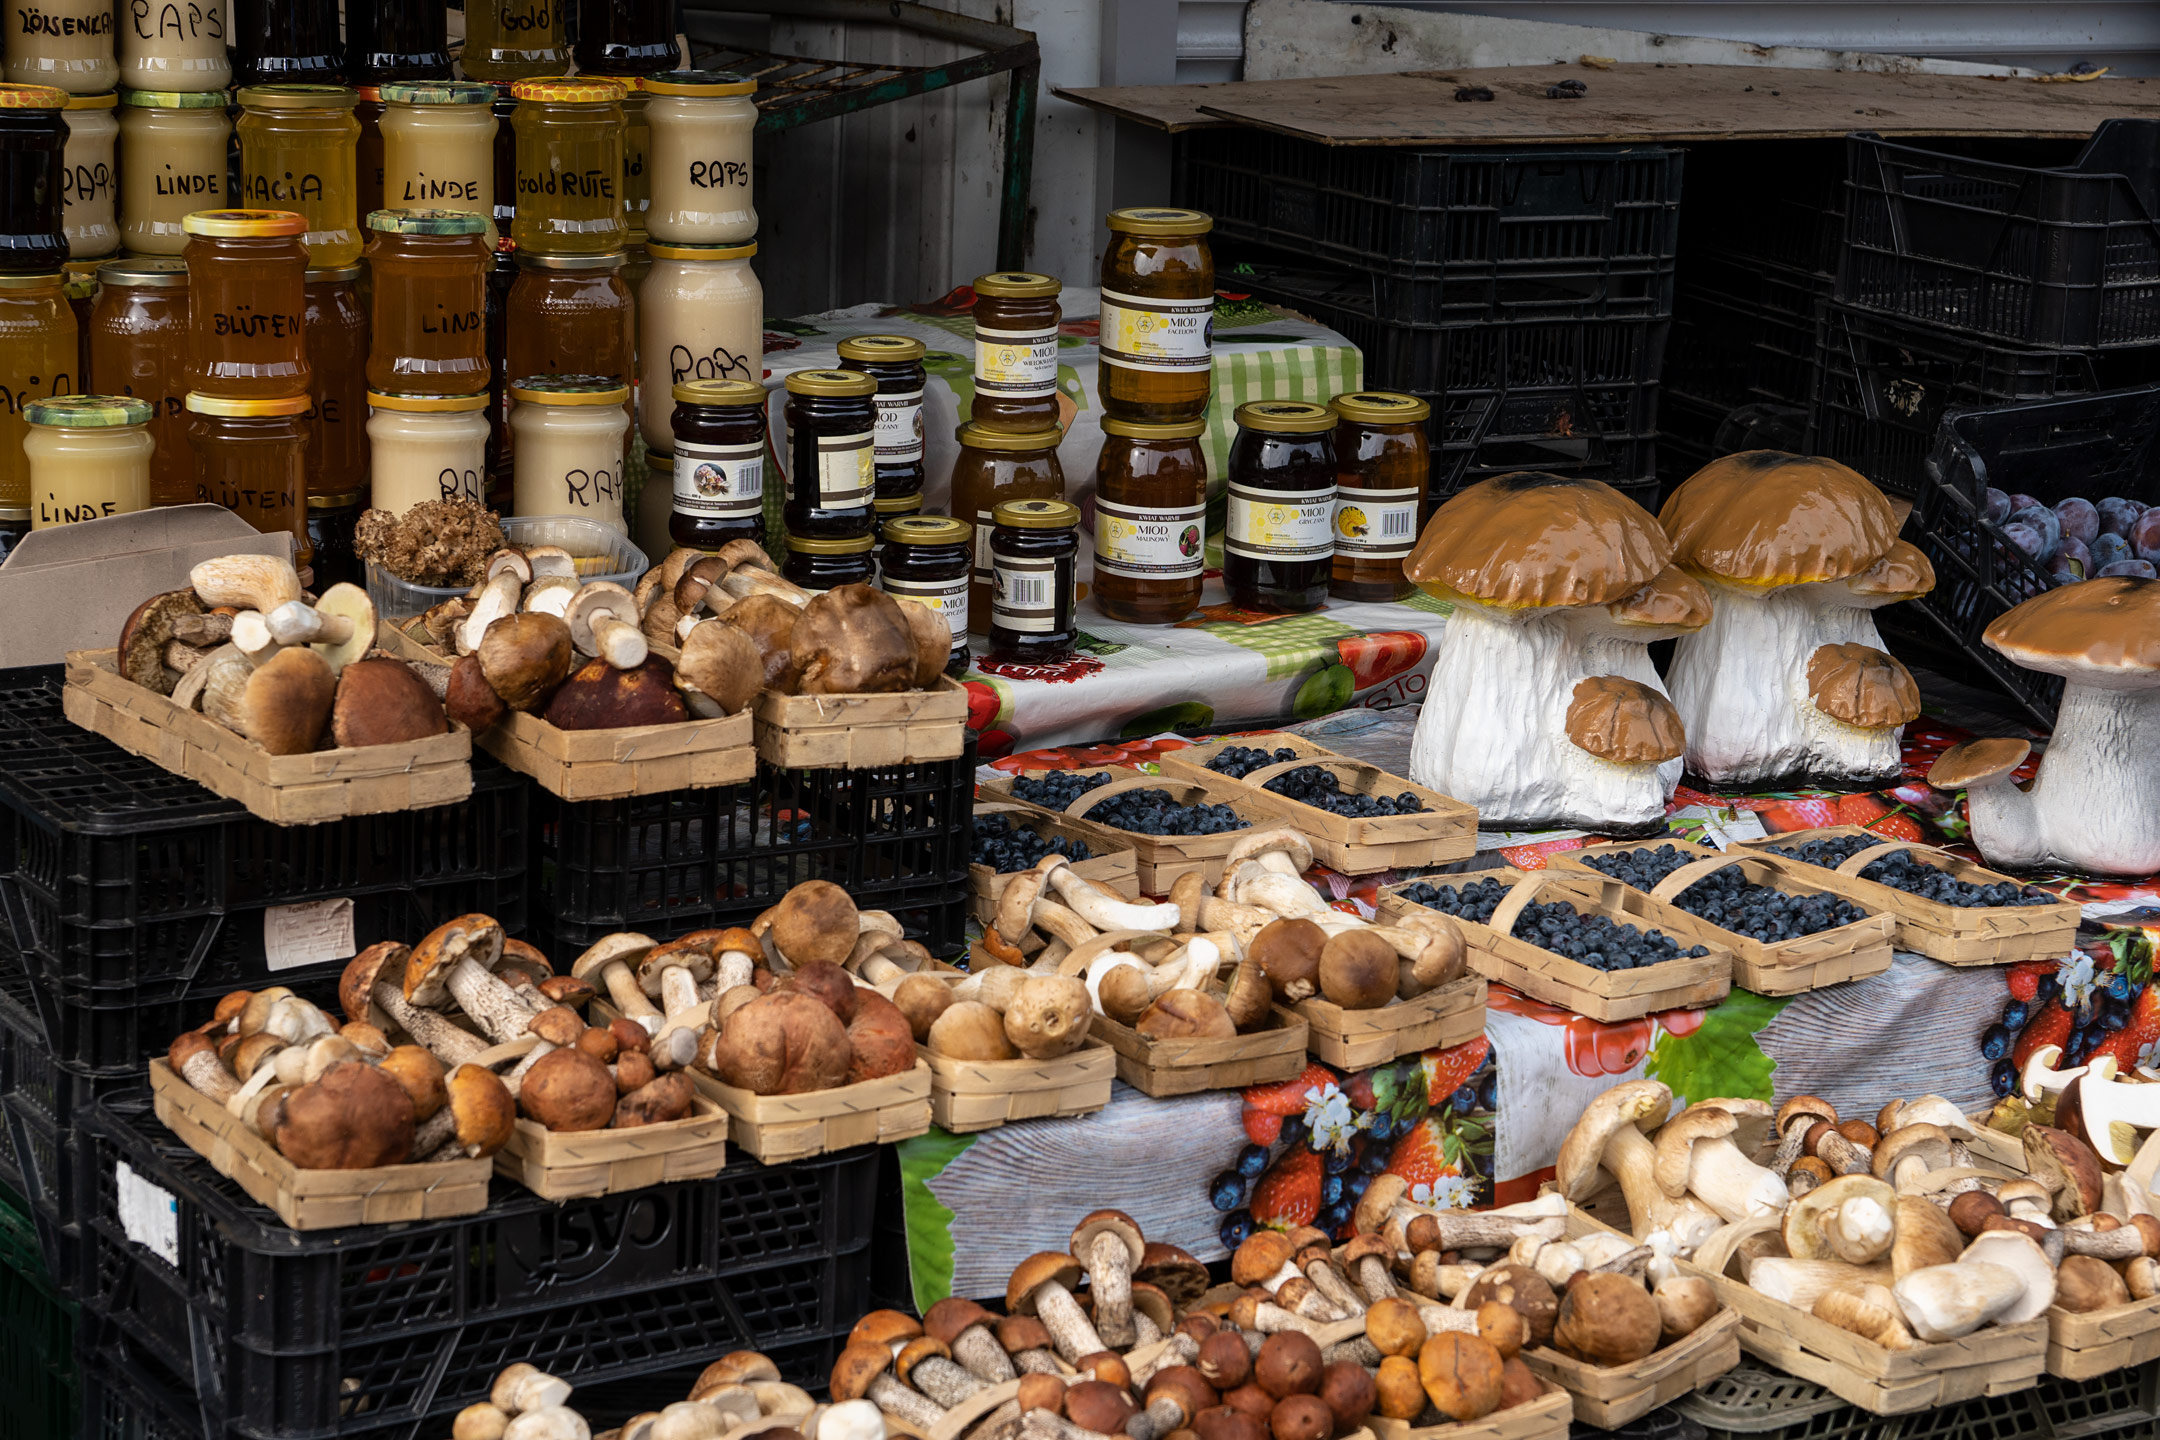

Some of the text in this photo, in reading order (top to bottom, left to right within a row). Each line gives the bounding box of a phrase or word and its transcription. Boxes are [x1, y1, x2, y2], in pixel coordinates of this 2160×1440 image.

[132, 0, 223, 41] RAPS
[155, 164, 219, 196] LINDE
[690, 160, 749, 189] RAPS
[403, 172, 479, 201] LINDE
[213, 305, 301, 338] BLÜTEN
[1170, 315, 1197, 328] MIÓD
[1032, 346, 1055, 358] MIÓD
[1300, 506, 1325, 518] MIÓD
[1138, 523, 1169, 536] MIÓD
[1136, 535, 1169, 543] MALINOWY
[943, 596, 966, 609] MIÓD
